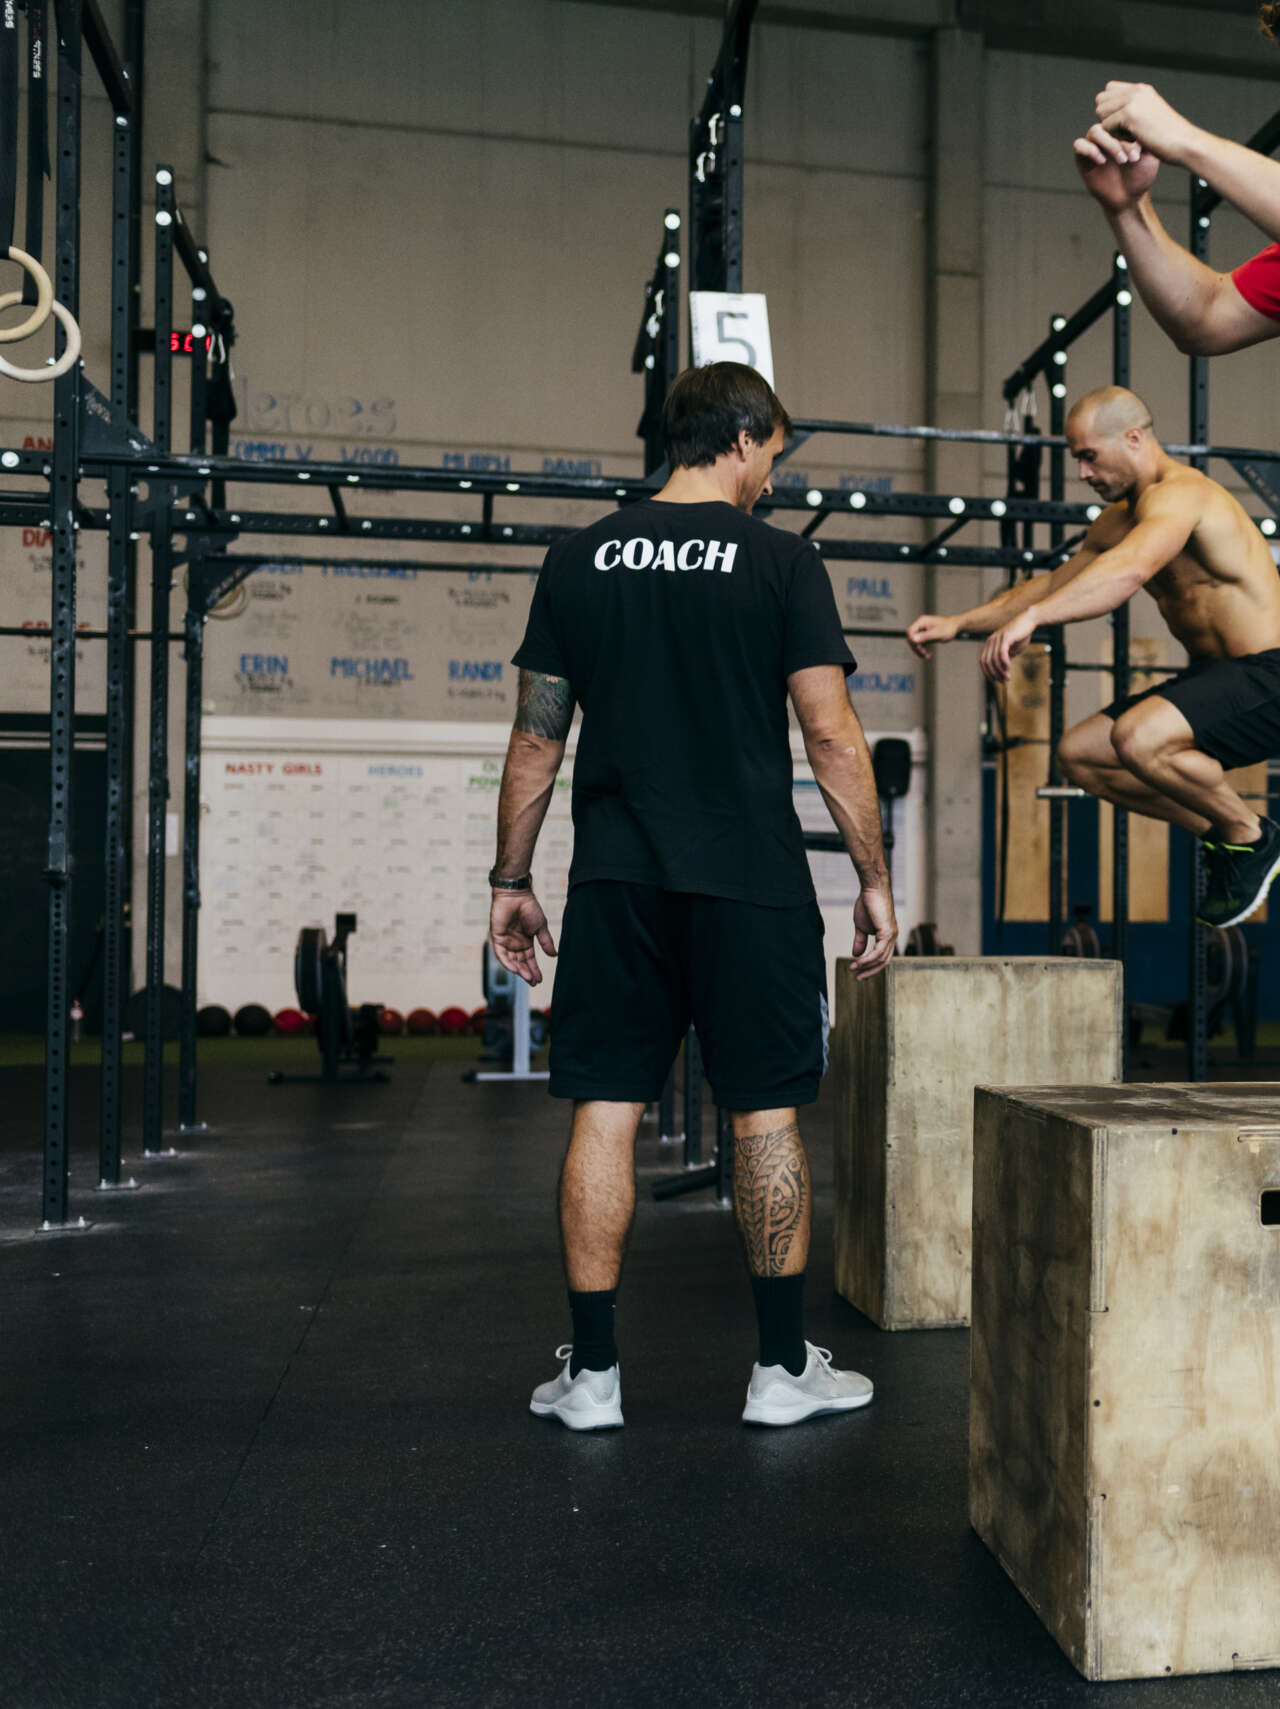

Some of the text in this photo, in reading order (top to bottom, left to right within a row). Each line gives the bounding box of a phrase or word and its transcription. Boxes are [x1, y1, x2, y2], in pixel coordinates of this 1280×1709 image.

[716, 311, 757, 367] 5
[594, 537, 738, 573] COACH
[847, 577, 892, 598] PAUL
[240, 653, 288, 676] ERIN
[330, 657, 415, 681] MICHAEL
[225, 762, 322, 776] NASTY GIRLS
